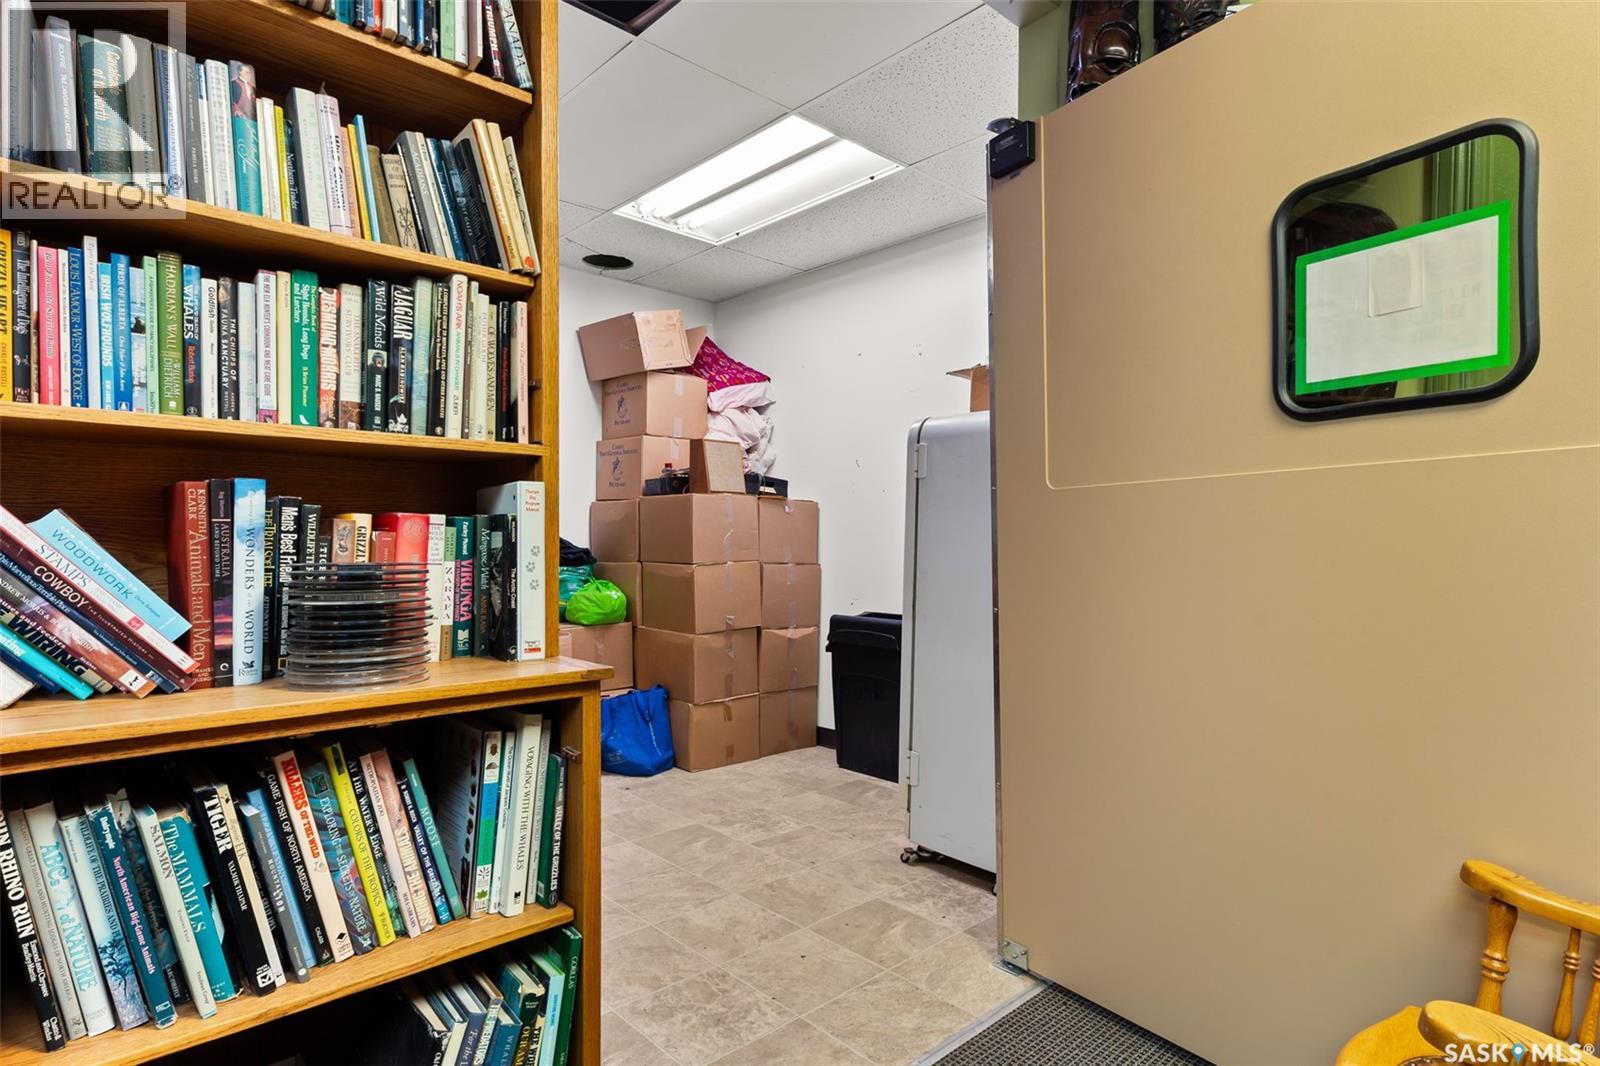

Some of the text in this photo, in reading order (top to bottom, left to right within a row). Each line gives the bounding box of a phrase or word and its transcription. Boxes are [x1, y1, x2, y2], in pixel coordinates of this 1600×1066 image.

[486, 5, 498, 51] TRIUMPH
[107, 51, 122, 96] Cavalcade
[286, 152, 300, 210] Northern Trader
[412, 151, 428, 194] ACADIANS
[17, 258, 30, 270] The
[118, 263, 126, 284] BIRDS
[13, 271, 28, 309] Intelligence
[100, 274, 112, 299] IRISH
[118, 287, 125, 297] OF
[166, 264, 178, 348] HADRIAN'S WALL
[208, 286, 216, 318] Goldfish
[302, 284, 310, 300] Sight
[456, 280, 464, 310] NOAH'S
[13, 317, 28, 334] Dogs
[70, 252, 84, 400] LOUIS L'AMOUR WEST OF DODGE
[184, 284, 194, 338] WHALES
[374, 286, 386, 348] Wild Minds
[394, 290, 414, 340] JAGUAR
[102, 302, 112, 367] WOLFHOUNDS
[302, 328, 310, 342] Long
[302, 344, 310, 360] Dogs
[320, 293, 338, 391] DESMOND MORRIS
[488, 326, 494, 338] OF
[188, 346, 196, 364] Robert
[230, 370, 236, 380] OF
[164, 357, 173, 398] DIETRICH
[173, 362, 181, 396] WILLIAM
[188, 488, 198, 520] CLARK
[198, 489, 207, 532] KENNETH
[264, 508, 273, 525] THE
[221, 523, 230, 576] AUSTRALIA
[264, 524, 276, 556] TRIALS
[279, 506, 298, 582] Man's Best Friend
[306, 514, 317, 554] WILDLIFE
[460, 522, 468, 540] Farley
[35, 543, 92, 588] STAMPS
[52, 529, 136, 600] WOODWORK
[264, 562, 274, 588] LIFE
[479, 528, 490, 590] Mongoose Watch
[34, 565, 88, 608] COWBOY
[189, 530, 210, 660] Animals and Men
[244, 528, 256, 654] WONDERS WORLD
[460, 559, 472, 622] VIRUNGA
[8, 615, 89, 676] WIRING
[348, 760, 358, 774] AT
[352, 776, 364, 794] THE
[281, 758, 320, 859] KILLERS OF THE WILD
[366, 762, 385, 818] METROPOLITAN ZOO
[516, 744, 535, 870] VOYAGING WITH THE WHALES
[99, 816, 116, 850] Dalrymple
[348, 808, 363, 842] COLORS
[358, 797, 374, 834] WATER'S
[420, 806, 440, 848] MOOSE
[150, 824, 172, 879] SALMON
[203, 794, 248, 912] TIGER VALMIK THAPAR
[236, 843, 246, 860] ELK
[266, 774, 312, 902] GAME FISH OF NORTH AMERICA
[356, 843, 366, 854] OF
[369, 836, 382, 860] EDGE
[395, 827, 420, 871] ANIMALS
[550, 806, 564, 890] VALLEY OF THE GRIZZLIES
[1, 852, 29, 903] RHINO
[78, 820, 115, 928] WILDLIFE OF THE PRAIRIES AND
[162, 824, 180, 852] The
[172, 854, 206, 934] MAMMALS
[268, 858, 282, 893] MOUNTAIN
[320, 797, 342, 844] EXPLORING
[336, 854, 354, 891] SECRETS
[350, 898, 368, 932] NATURE
[360, 856, 370, 872] THE
[412, 824, 442, 898] VALLEY OF THE GRIZZLIES
[272, 890, 286, 912] LION
[364, 873, 382, 908] TROPICS
[406, 874, 426, 890] THE
[12, 904, 35, 938] RUN
[112, 856, 124, 876] North
[118, 876, 134, 911] American
[126, 912, 144, 946] Big-Game
[138, 946, 155, 974] Animals
[411, 893, 436, 927] SAVING
[21, 942, 37, 982] Bradley Martin
[60, 914, 72, 924] of
[66, 924, 98, 992] NATURE
[568, 956, 578, 988] GORILLAS
[42, 1020, 53, 1041] Windus
[50, 1016, 61, 1034] Chatto
[462, 1029, 478, 1060] For the
[474, 1004, 500, 1066] THE PREDATORS
